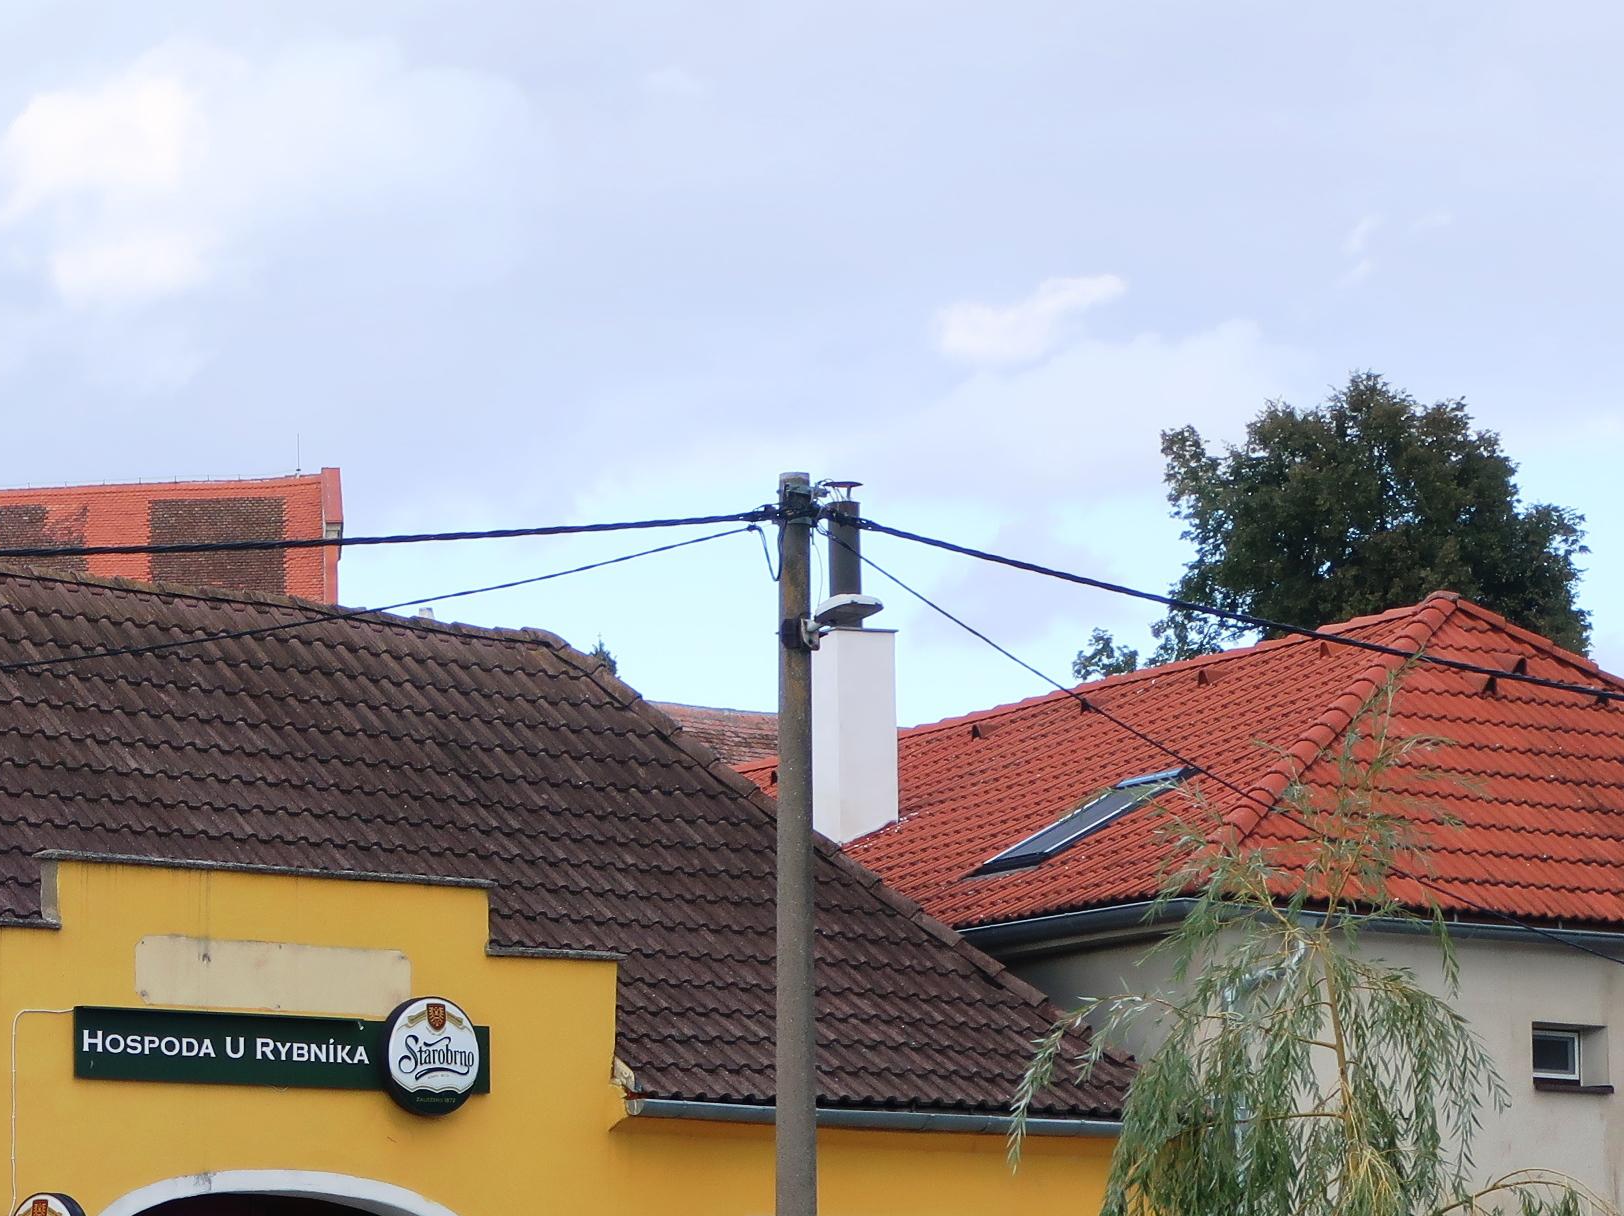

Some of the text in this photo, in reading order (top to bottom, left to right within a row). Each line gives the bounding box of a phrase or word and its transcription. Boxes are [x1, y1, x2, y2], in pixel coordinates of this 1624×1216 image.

[82, 1029, 370, 1065] HOSPODA U RYBNÍKA
[398, 1034, 475, 1081] Starobrno
